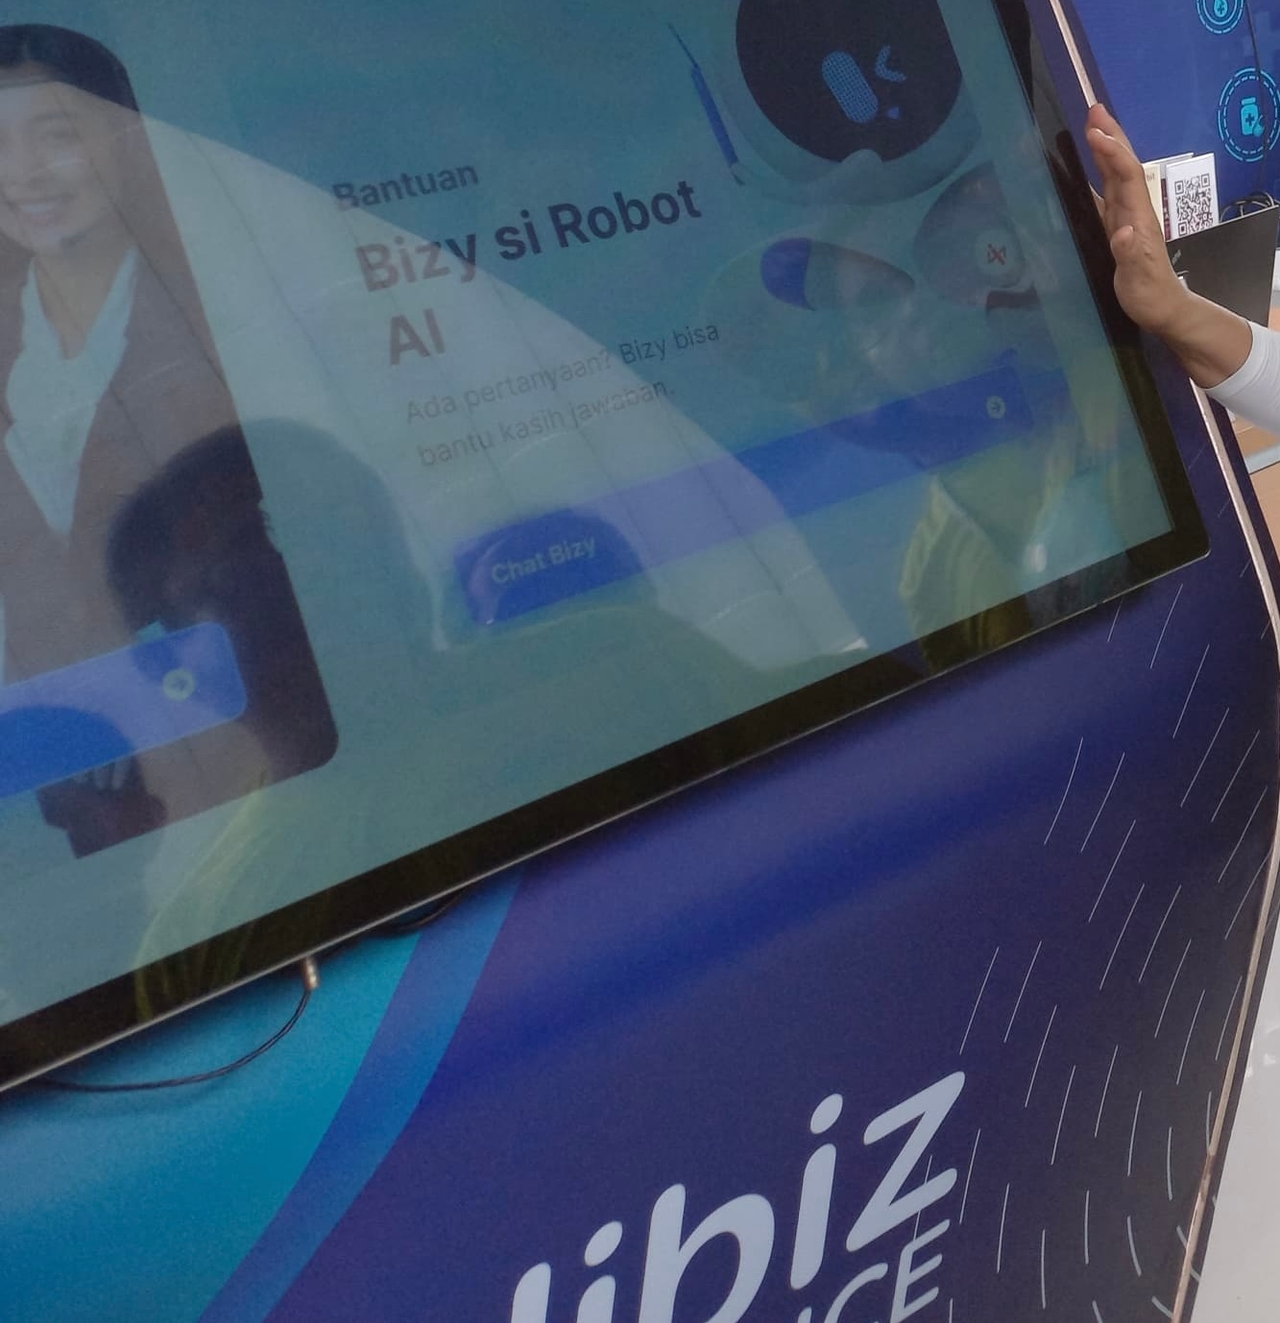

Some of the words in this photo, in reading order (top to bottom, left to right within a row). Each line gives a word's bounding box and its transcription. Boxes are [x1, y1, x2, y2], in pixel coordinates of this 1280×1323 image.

[332, 164, 480, 212] Bantuan
[354, 232, 478, 293] Bizy
[494, 209, 542, 261] si
[547, 180, 703, 249] Robot
[388, 307, 447, 366] AI
[405, 394, 458, 426] Ada
[464, 348, 613, 411] pertanyaan?
[618, 337, 667, 366] Bizy
[673, 322, 720, 351] bisa
[417, 428, 494, 467] bantu
[500, 408, 566, 442] kasih
[491, 552, 547, 584] Chat
[548, 537, 597, 566] Bizy
